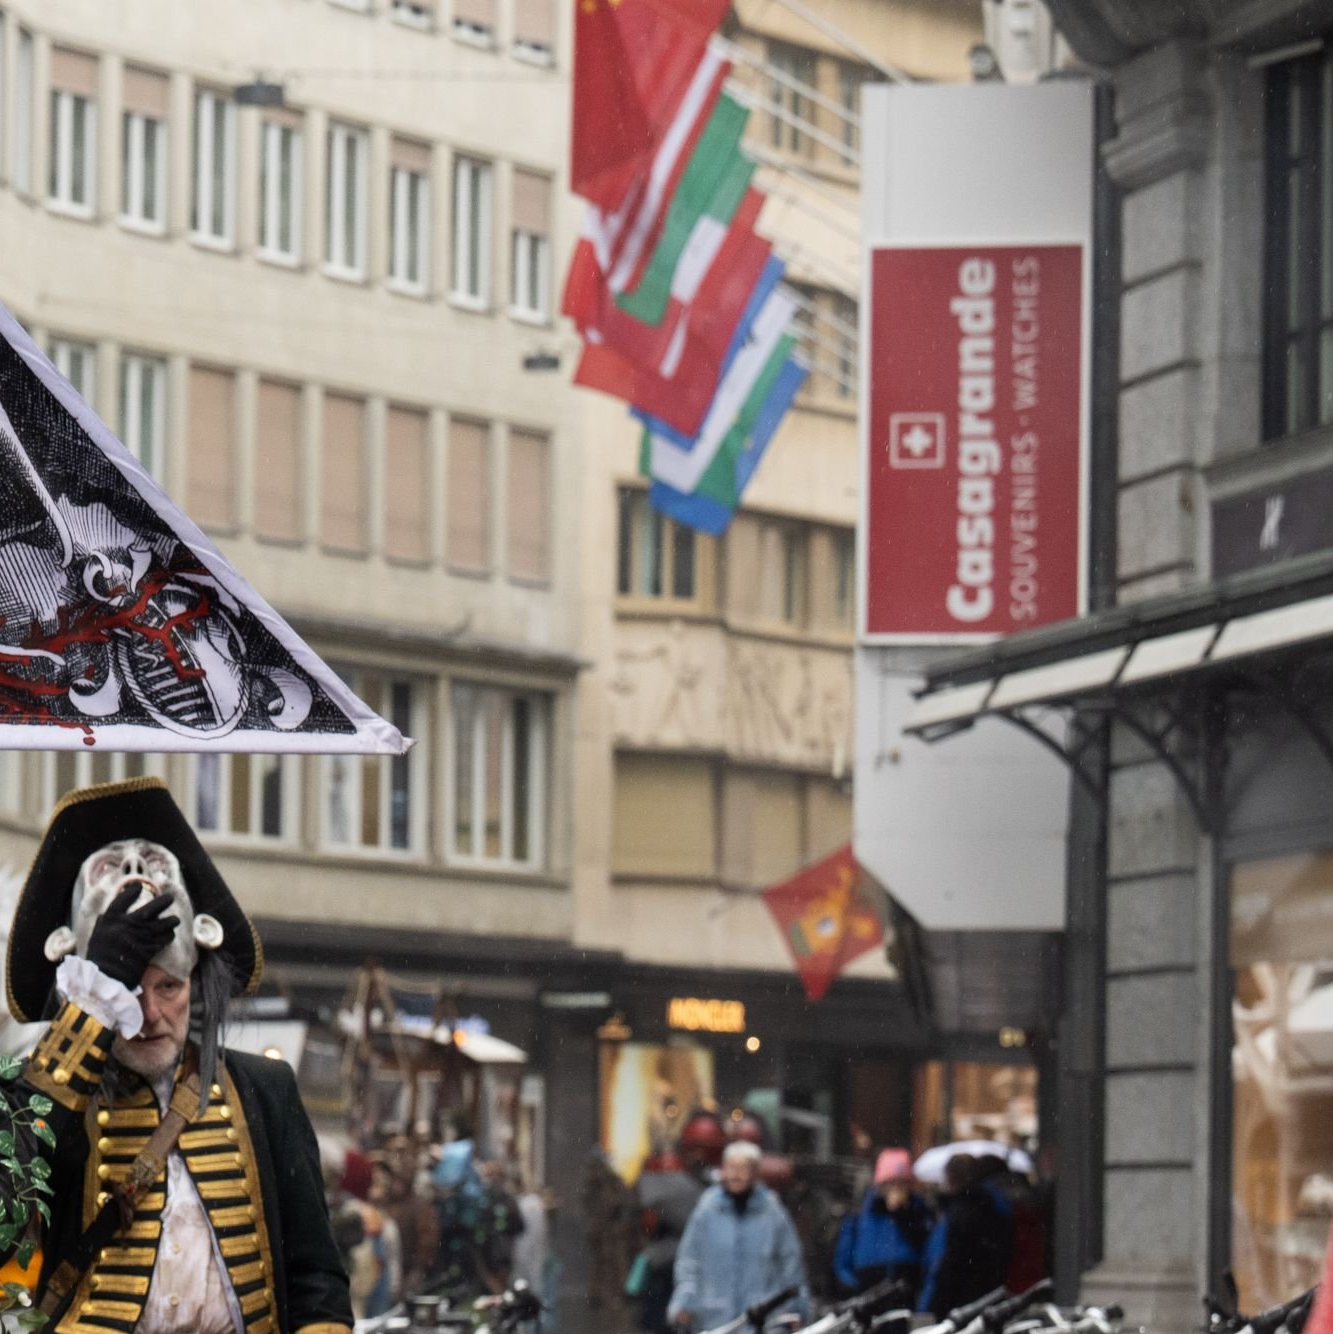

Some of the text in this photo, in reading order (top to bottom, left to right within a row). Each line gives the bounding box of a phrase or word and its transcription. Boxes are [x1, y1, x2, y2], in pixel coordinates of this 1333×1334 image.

[946, 255, 1002, 623] Casagrande
[1009, 255, 1039, 622] SOUVENIRS WATCHES
